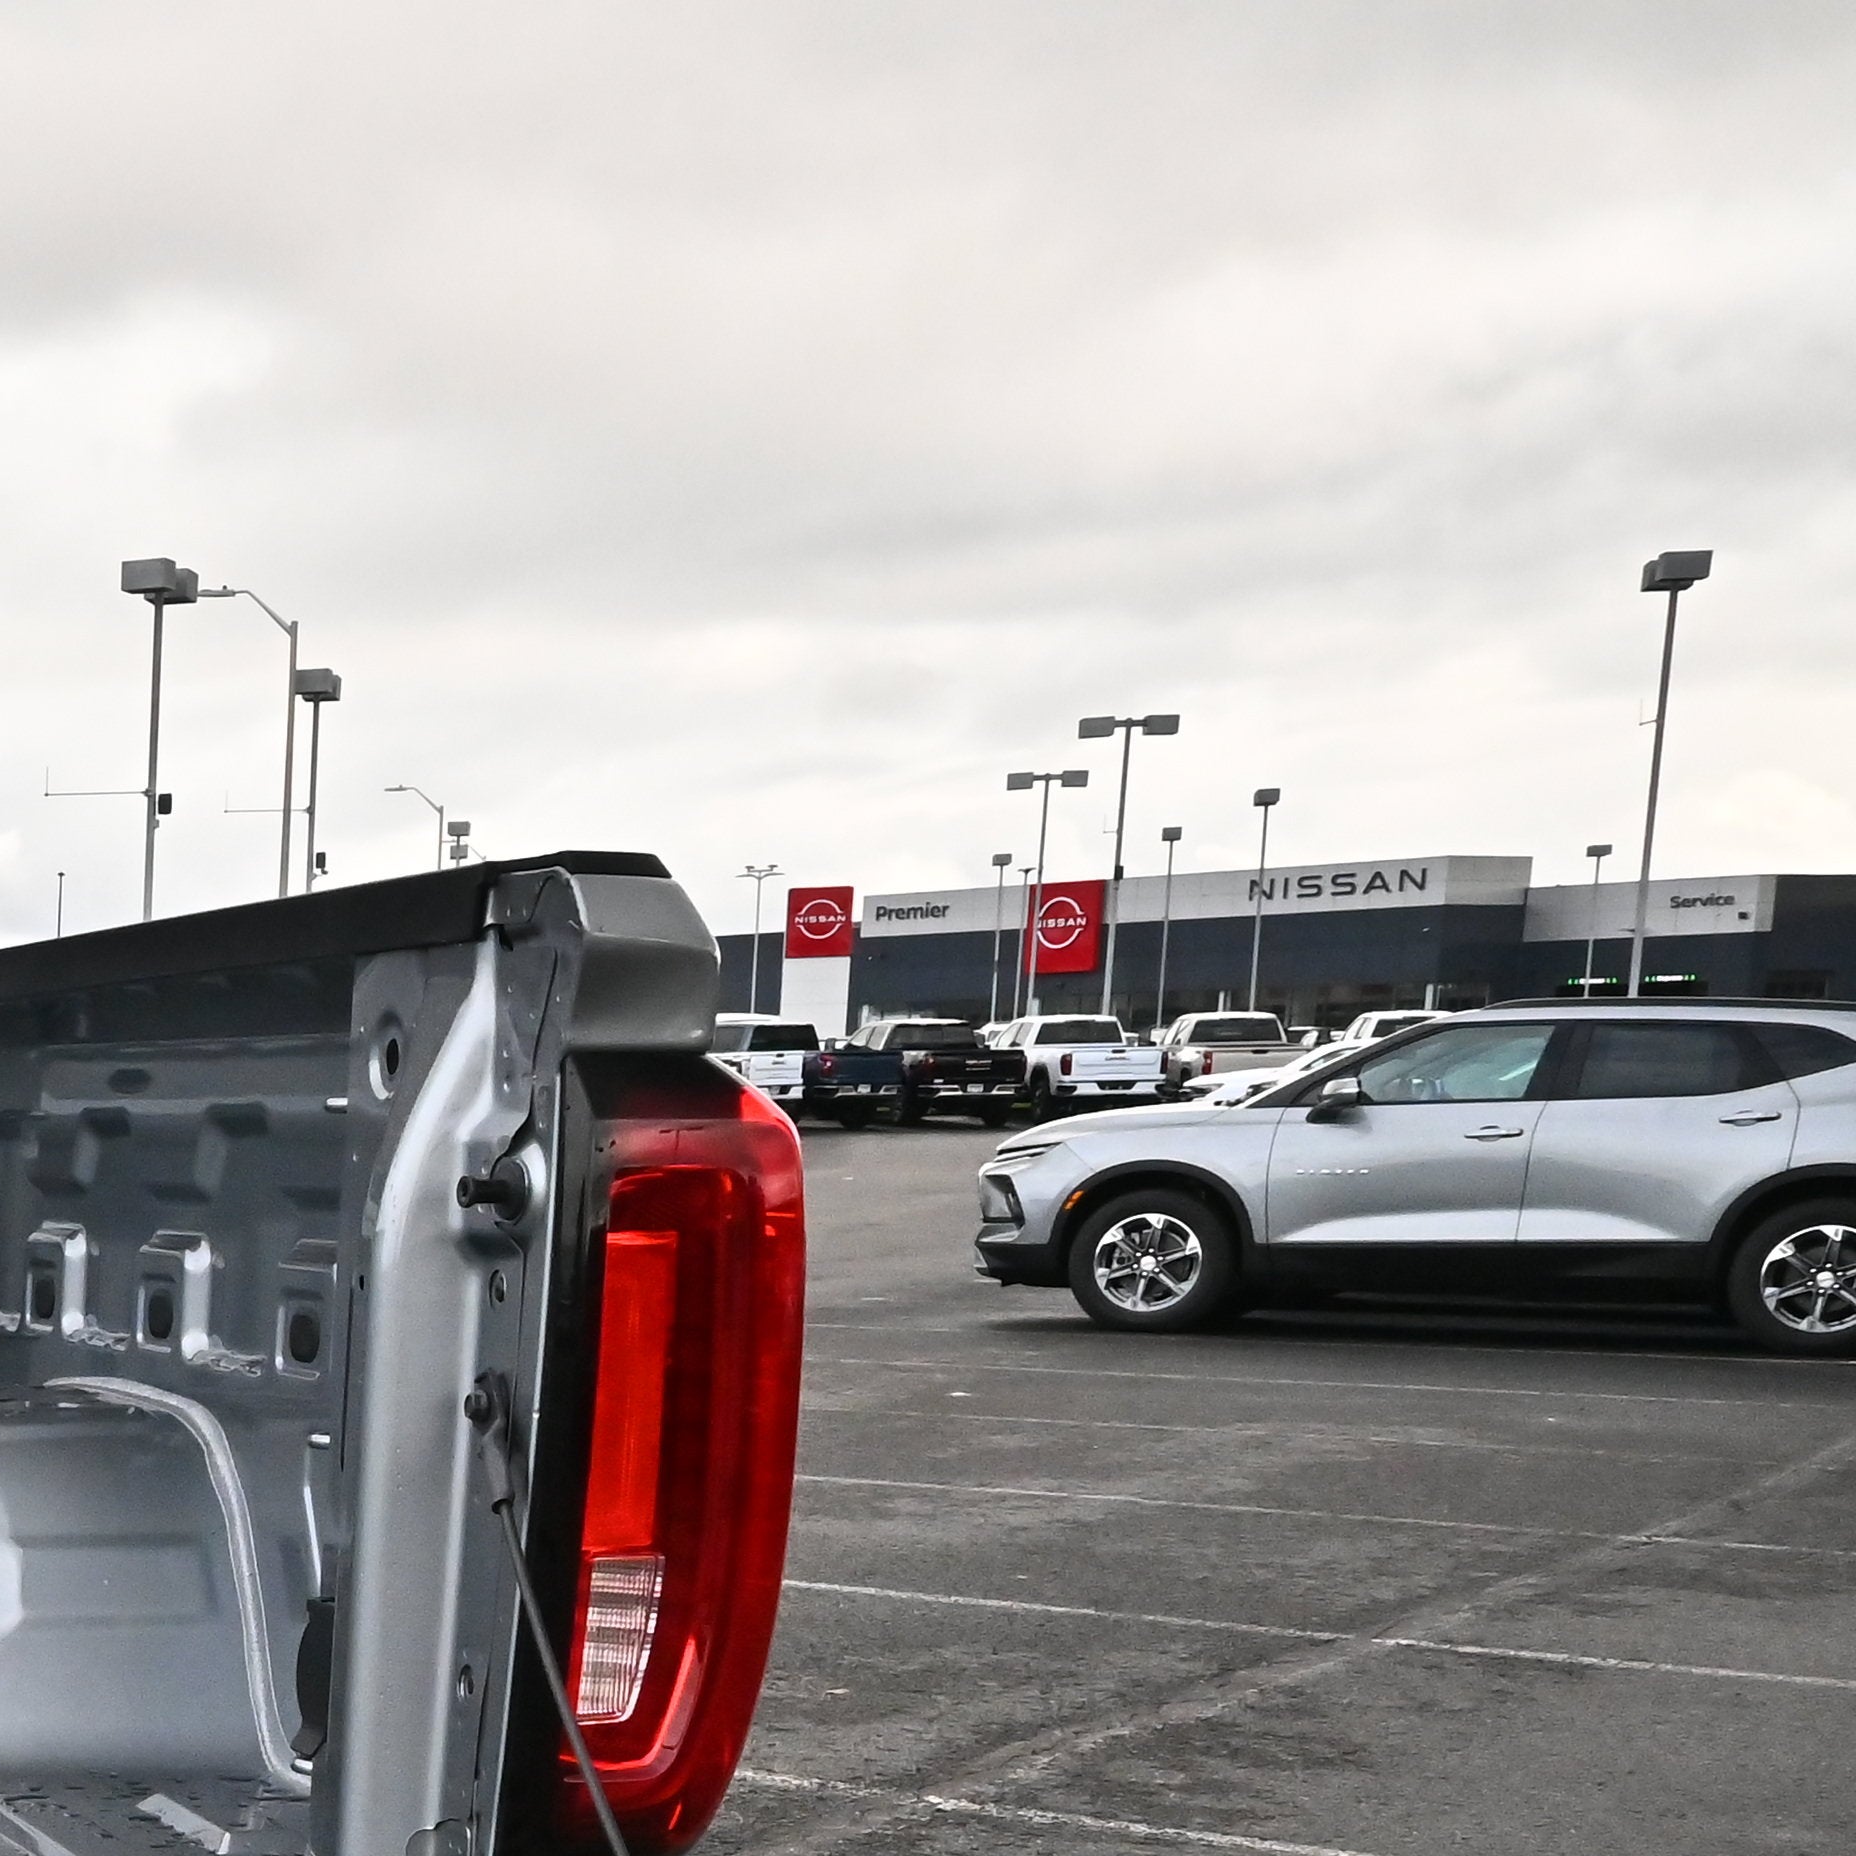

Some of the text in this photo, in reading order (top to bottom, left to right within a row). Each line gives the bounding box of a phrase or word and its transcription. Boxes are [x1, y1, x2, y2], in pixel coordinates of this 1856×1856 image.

[1248, 867, 1428, 901] NISSAN
[1669, 892, 1735, 909] Service
[794, 914, 846, 924] NISSAN
[875, 901, 951, 921] Premier
